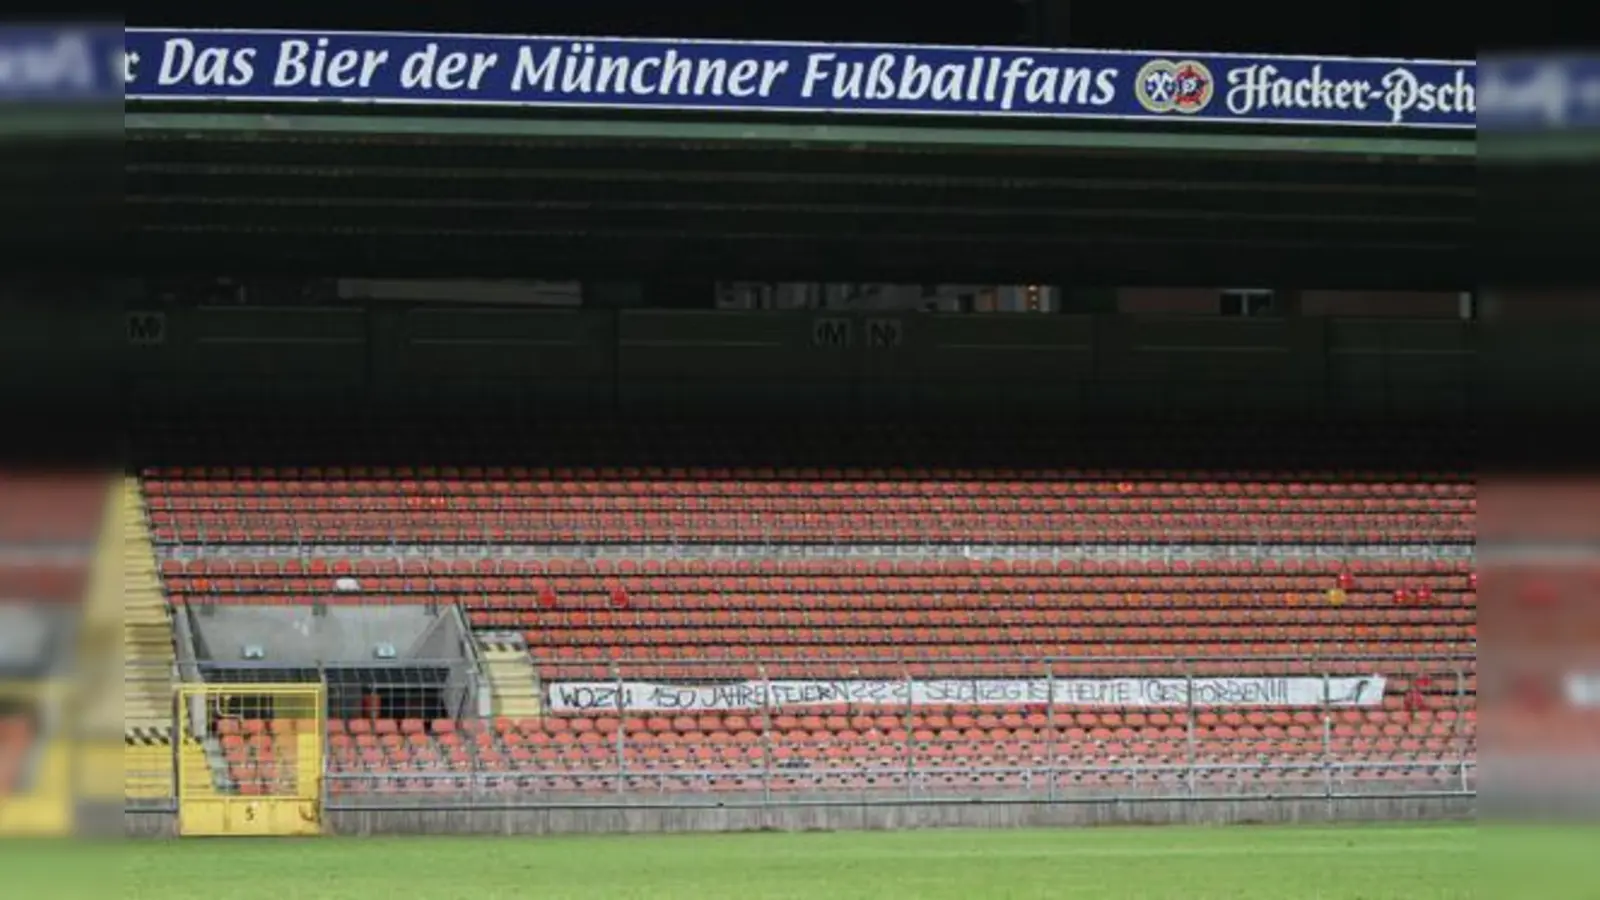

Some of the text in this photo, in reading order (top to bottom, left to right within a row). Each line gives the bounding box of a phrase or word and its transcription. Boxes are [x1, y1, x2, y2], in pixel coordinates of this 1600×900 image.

[158, 38, 1118, 109] Das Bier der Münchner Fußballfans
[1226, 63, 1477, 123] Hacker-Psch
